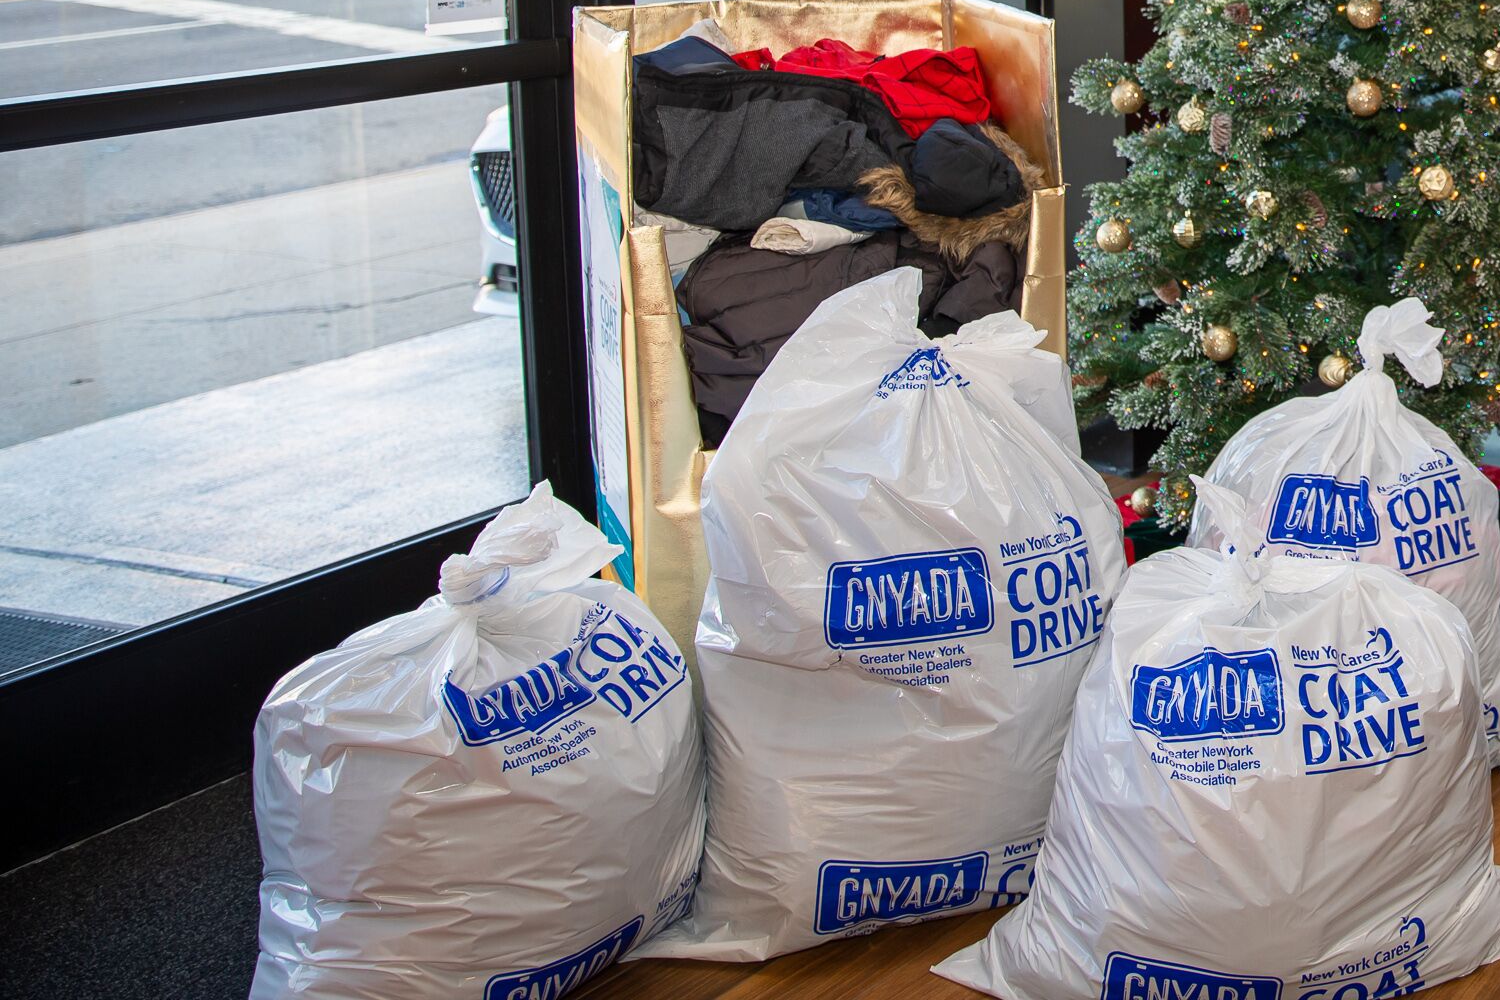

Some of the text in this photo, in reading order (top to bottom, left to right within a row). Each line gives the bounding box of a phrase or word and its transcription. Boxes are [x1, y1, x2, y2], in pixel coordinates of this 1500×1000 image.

[1387, 474, 1466, 532] COAT
[999, 542, 1026, 559] New
[1393, 516, 1476, 570] DRIVE
[844, 565, 976, 631] GNYADA
[1007, 548, 1093, 614] COAT
[1011, 594, 1104, 660] DRIVE
[858, 657, 973, 676] utomobile Dealers
[859, 644, 965, 665] Greater New York
[1291, 645, 1320, 661] New
[1340, 650, 1381, 668] Cares
[1145, 663, 1265, 726] GNYADA
[1298, 656, 1411, 720] COAT
[503, 736, 546, 756] Greate
[1301, 702, 1426, 766] DRIVE
[1150, 751, 1261, 773] Automobile Dealers
[1170, 770, 1237, 787] Association
[1003, 841, 1034, 858] New
[837, 869, 965, 921] GNYADA
[1301, 940, 1411, 984] New York Cares
